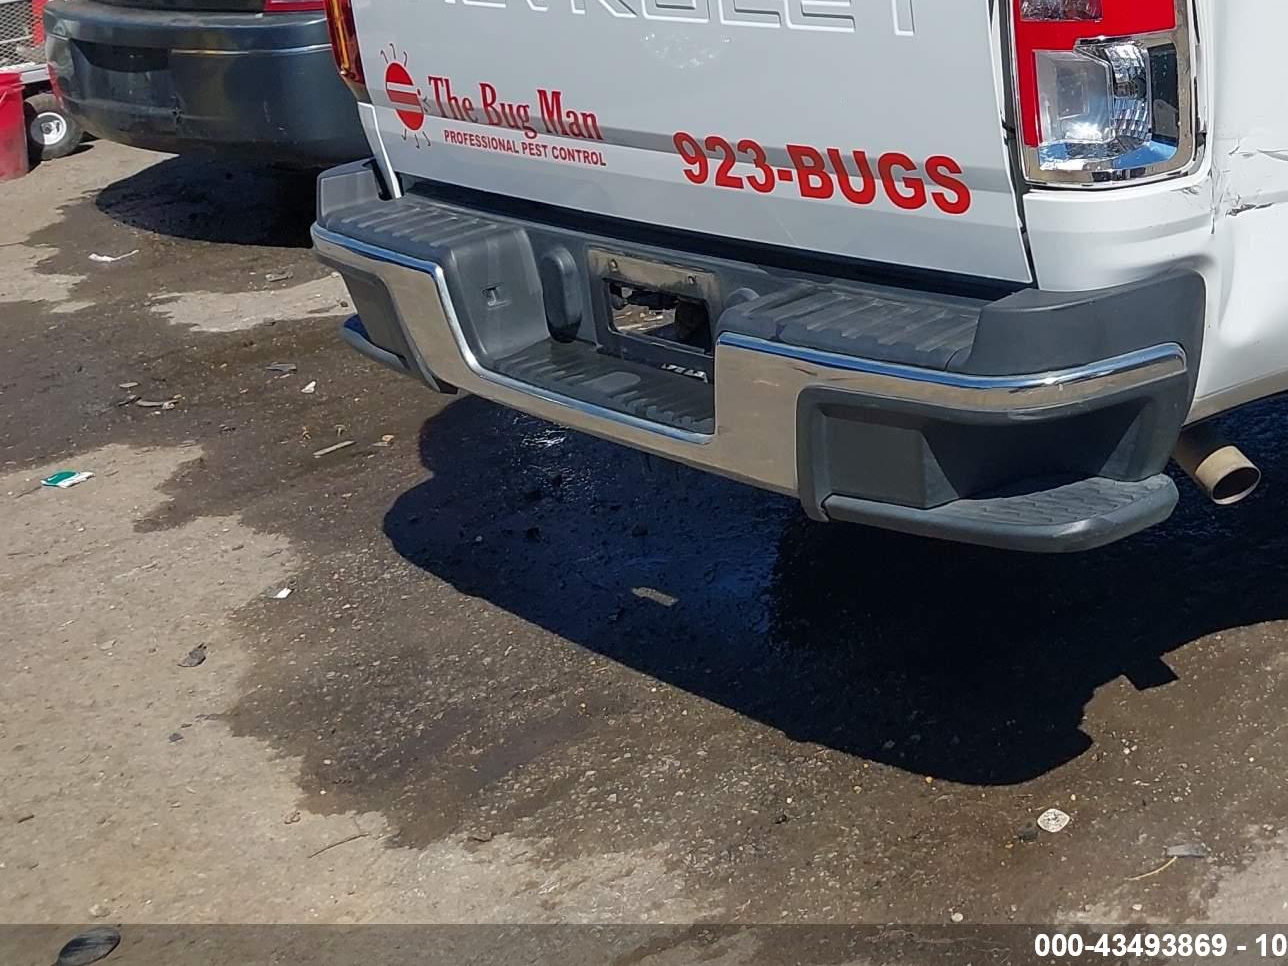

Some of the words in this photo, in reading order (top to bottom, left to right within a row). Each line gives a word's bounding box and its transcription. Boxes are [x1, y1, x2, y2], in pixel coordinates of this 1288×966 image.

[427, 75, 479, 124] The
[478, 82, 538, 140] Bug
[536, 88, 604, 141] Man
[443, 129, 520, 154] PROFESSIONAL
[521, 141, 549, 158] PEST
[551, 146, 607, 167] CONTROL
[672, 130, 972, 216] 923-BUGS
